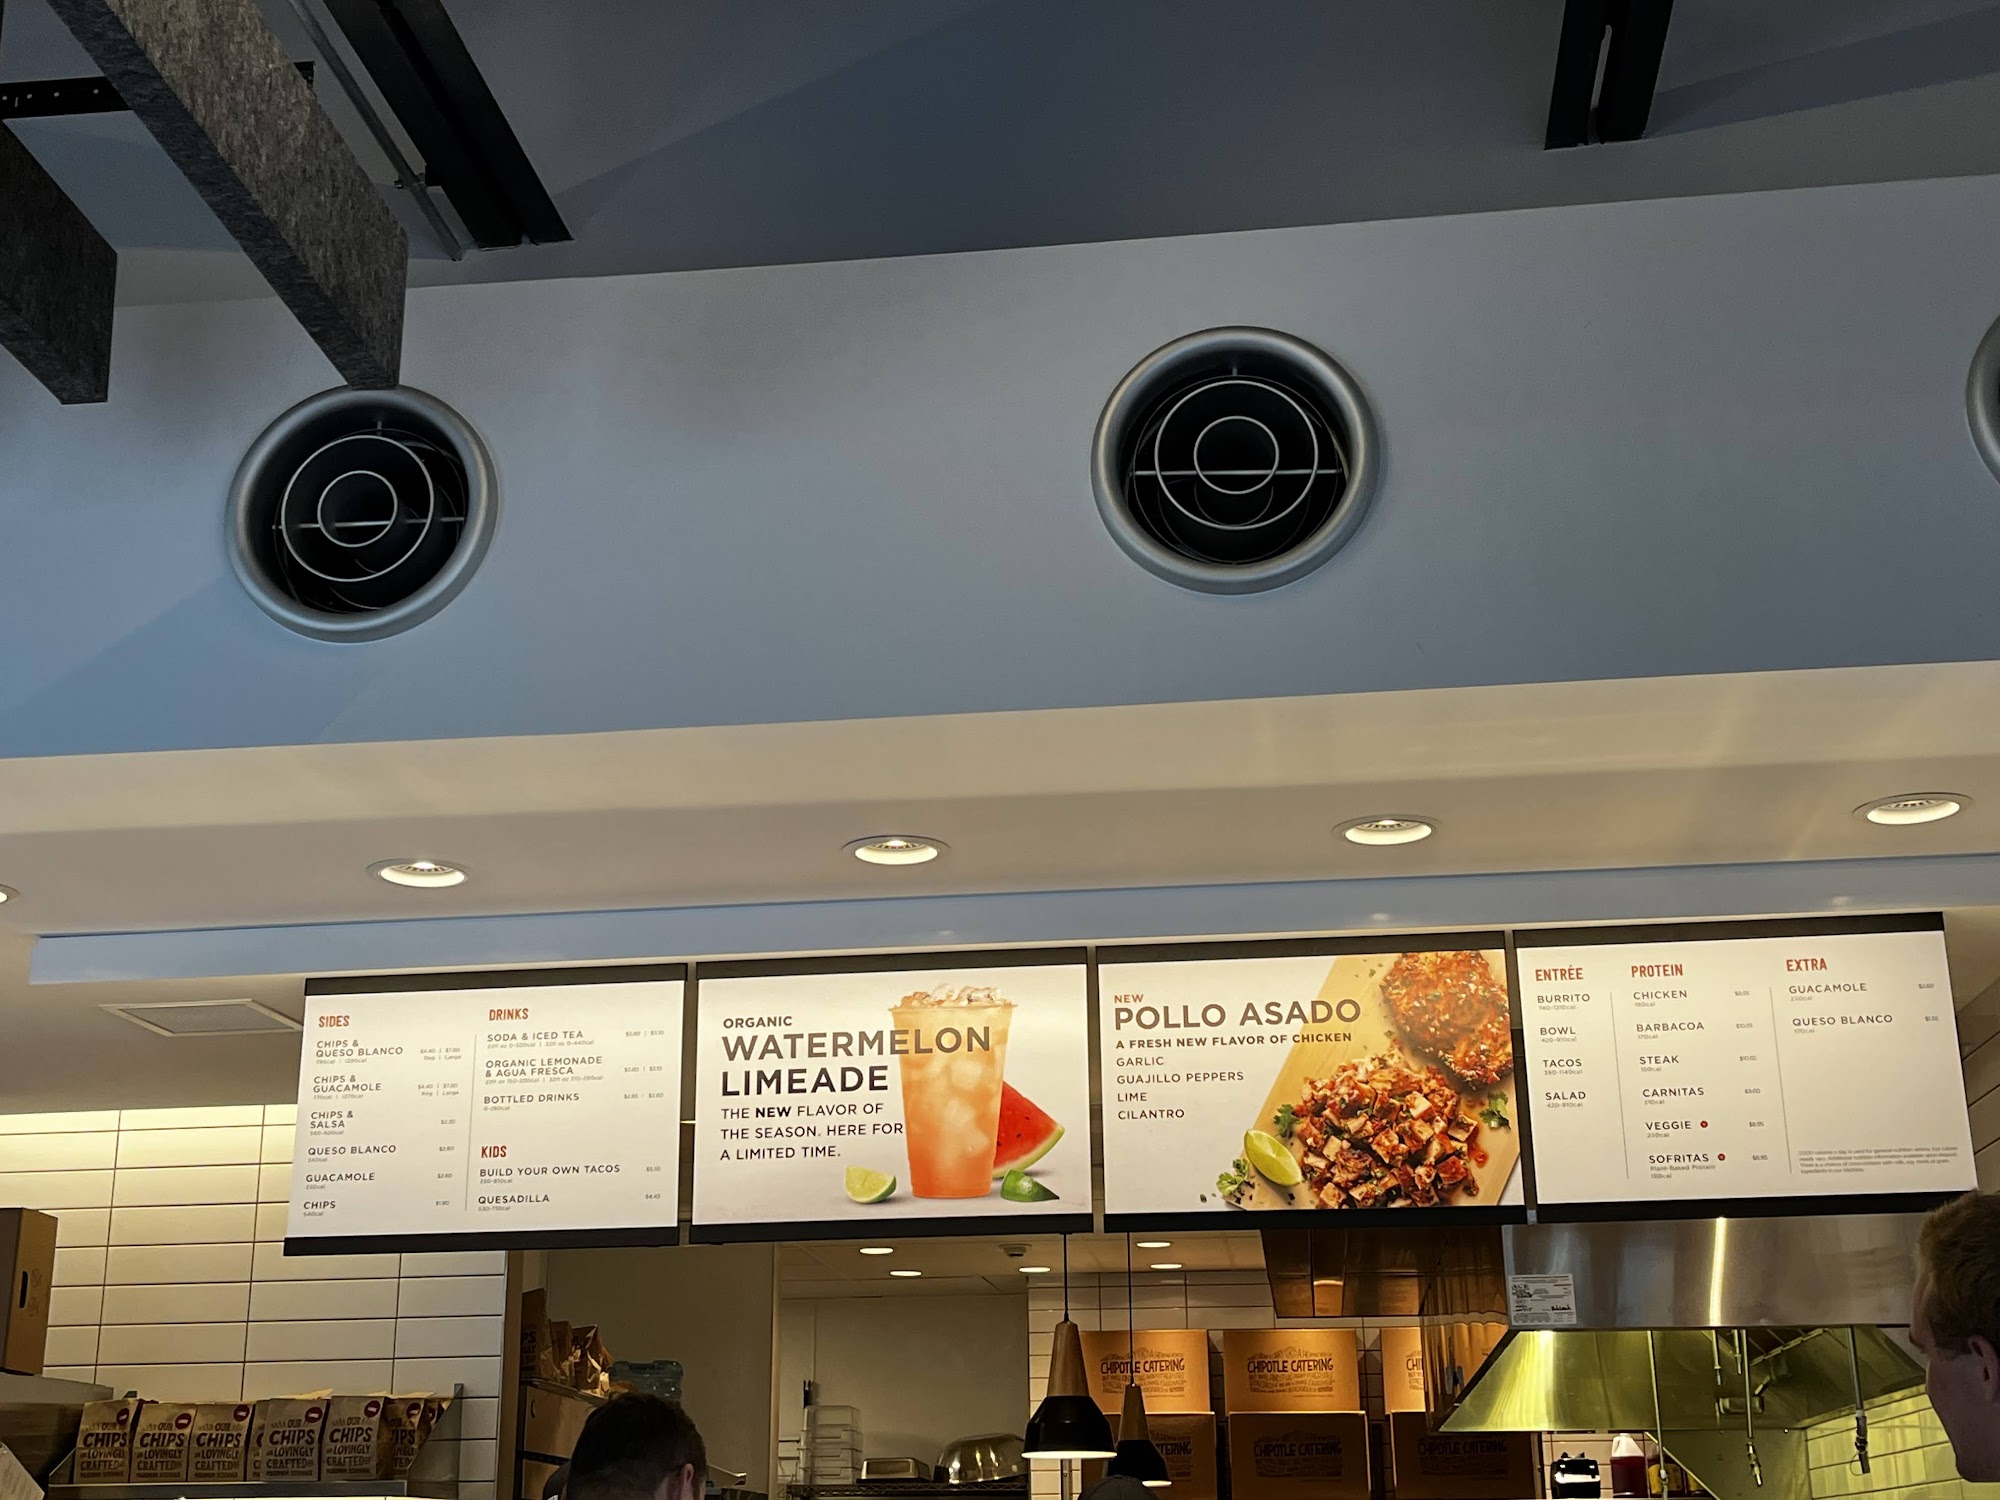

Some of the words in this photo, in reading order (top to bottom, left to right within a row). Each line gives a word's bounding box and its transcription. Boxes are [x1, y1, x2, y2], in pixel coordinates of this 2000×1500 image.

[1786, 958, 1828, 972] EXTRA
[1535, 964, 1583, 982] ENTRÉE
[1631, 964, 1683, 978] PROTEIN
[1789, 983, 1867, 994] GUACAMOLE
[1114, 994, 1144, 1004] NEW
[1537, 993, 1590, 1003] BURRITO
[1633, 990, 1687, 1000] CHICKEN
[489, 1008, 529, 1021] DRINKS
[1114, 1003, 1227, 1031] POLLO
[1239, 998, 1361, 1026] ASADO
[319, 1015, 350, 1028] SIDES
[723, 1015, 793, 1030] ORGANIC
[1792, 1016, 1836, 1027] QUESO
[1841, 1014, 1893, 1025] BLANCO
[1540, 1027, 1576, 1036] BOWL
[1636, 1022, 1704, 1032] BARBACOA
[487, 1033, 517, 1042] SODA
[532, 1032, 558, 1040] ICED
[1115, 1040, 1125, 1049] A
[1129, 1038, 1171, 1049] FRESH
[1177, 1038, 1207, 1047] NEW
[1212, 1036, 1265, 1046] FLAVOR
[1270, 1035, 1288, 1044] OF
[1292, 1032, 1352, 1043] CHICKEN
[316, 1040, 348, 1048] CHIPS
[721, 1026, 991, 1062] WATERMELON
[316, 1048, 354, 1058] QUESO
[358, 1047, 403, 1056] BLANCO
[485, 1058, 536, 1068] ORGANIC
[540, 1056, 603, 1066] LEMONADE
[1116, 1056, 1165, 1067] GARLIC
[1542, 1059, 1582, 1068] TACOS
[1640, 1055, 1680, 1064] STEAK
[485, 1070, 492, 1078] &
[496, 1068, 526, 1077] AGUA
[531, 1067, 574, 1075] FRESCA
[1116, 1074, 1181, 1085] GUAJILLO
[1186, 1071, 1244, 1082] PEPPERS
[314, 1075, 345, 1084] CHIPS
[721, 1065, 889, 1097] LIMEADE
[313, 1083, 381, 1093] GUACAMOLE
[1642, 1087, 1704, 1098] CARNITAS
[483, 1094, 534, 1104] BOTTLED
[538, 1093, 580, 1102] DRINKS
[1117, 1092, 1148, 1102] LIME
[1545, 1091, 1586, 1101] SALAD
[311, 1111, 343, 1119] CHIPS
[347, 1110, 353, 1118] &
[721, 1107, 750, 1120] THE
[755, 1106, 792, 1118] NEW
[797, 1104, 857, 1117] FLAVOR
[863, 1103, 884, 1115] OF
[1118, 1109, 1185, 1120] CILANTRO
[310, 1120, 345, 1128] SALSA
[1645, 1121, 1692, 1130] VEGGIE
[720, 1128, 749, 1140] THE
[755, 1126, 821, 1139] SEASON.
[827, 1124, 867, 1136] HERE
[872, 1122, 904, 1135] FOR
[308, 1146, 346, 1156] QUESO
[350, 1145, 397, 1154] BLANCO
[481, 1145, 507, 1158] KIDS
[720, 1150, 731, 1161] A
[736, 1147, 795, 1160] LIMITED
[801, 1146, 841, 1157] TIME.
[1649, 1154, 1709, 1164] SOFRITAS
[480, 1168, 513, 1177] BUILD
[517, 1167, 548, 1176] YOUR
[552, 1166, 580, 1174] OWN
[584, 1164, 620, 1173] TACOS
[306, 1172, 375, 1182] GUACAMOLE
[478, 1194, 550, 1204] QUESADILLA
[303, 1201, 336, 1209] CHIPS
[1143, 1358, 1185, 1373] CATERING
[1248, 1360, 1288, 1373] CHIPOTLE
[1291, 1357, 1333, 1372] CATERING
[102, 1422, 117, 1431] OUR
[158, 1423, 173, 1431] OUR
[215, 1423, 231, 1431] OUR
[288, 1419, 301, 1428] OUR
[347, 1417, 361, 1426] OUR
[83, 1432, 127, 1448] CHIPS
[139, 1432, 185, 1448] CHIPS
[196, 1432, 242, 1447] CHIPS
[269, 1430, 315, 1445] CHIPS
[329, 1427, 373, 1443] CHIPS
[274, 1447, 313, 1457] LOVINGLY
[334, 1445, 371, 1454] LOVINGLY
[1154, 1440, 1192, 1456] ATERING
[1254, 1443, 1297, 1457] CHIPOTLE
[1298, 1440, 1342, 1456] CATERING
[144, 1450, 182, 1459] LOVINGLY
[202, 1450, 238, 1459] LOVINGLY
[80, 1460, 118, 1471] CRAFTED
[137, 1460, 176, 1471] CRAFTED
[195, 1461, 233, 1471] CRAFTED
[266, 1458, 307, 1469] CRAFTED
[327, 1457, 365, 1466] CRAFTED
